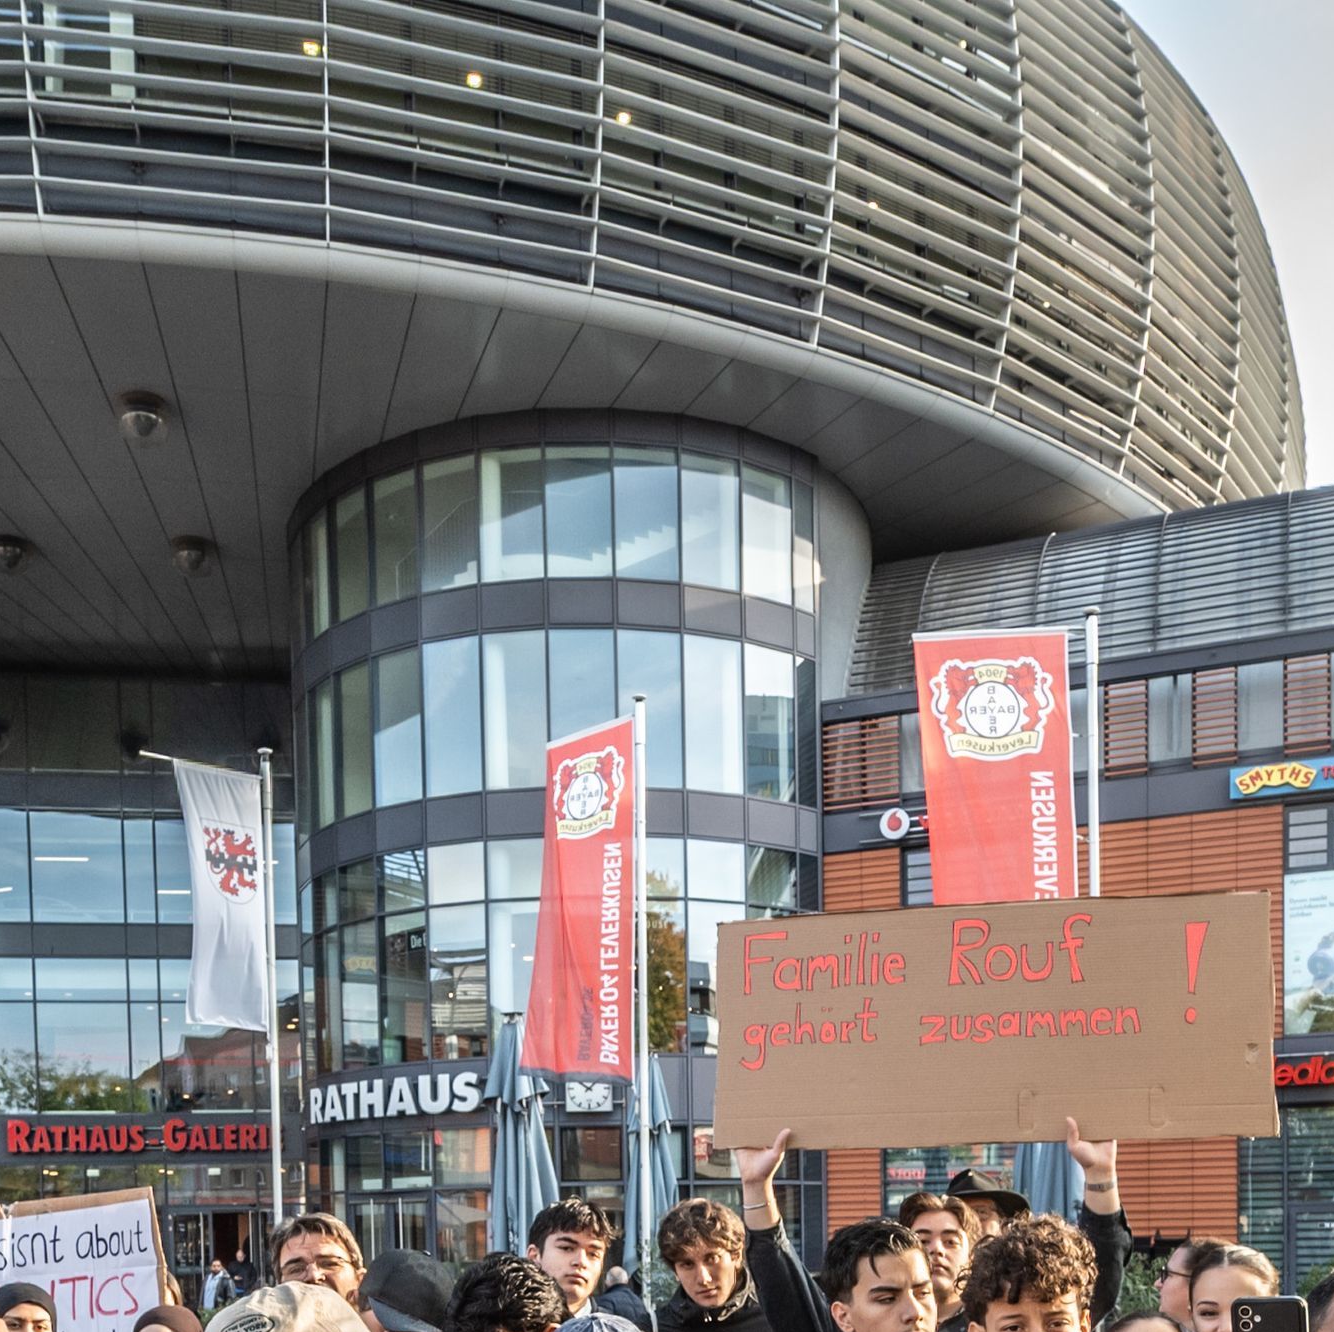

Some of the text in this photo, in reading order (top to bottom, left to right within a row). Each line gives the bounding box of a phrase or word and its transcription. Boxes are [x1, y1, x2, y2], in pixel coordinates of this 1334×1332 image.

[1238, 766, 1314, 793] SMYTHS
[743, 913, 1094, 996] Familie Rouf
[739, 997, 879, 1071] gehört
[919, 1004, 1142, 1046] zusammen
[309, 1073, 481, 1126] RATHAUS
[75, 1220, 148, 1260] about
